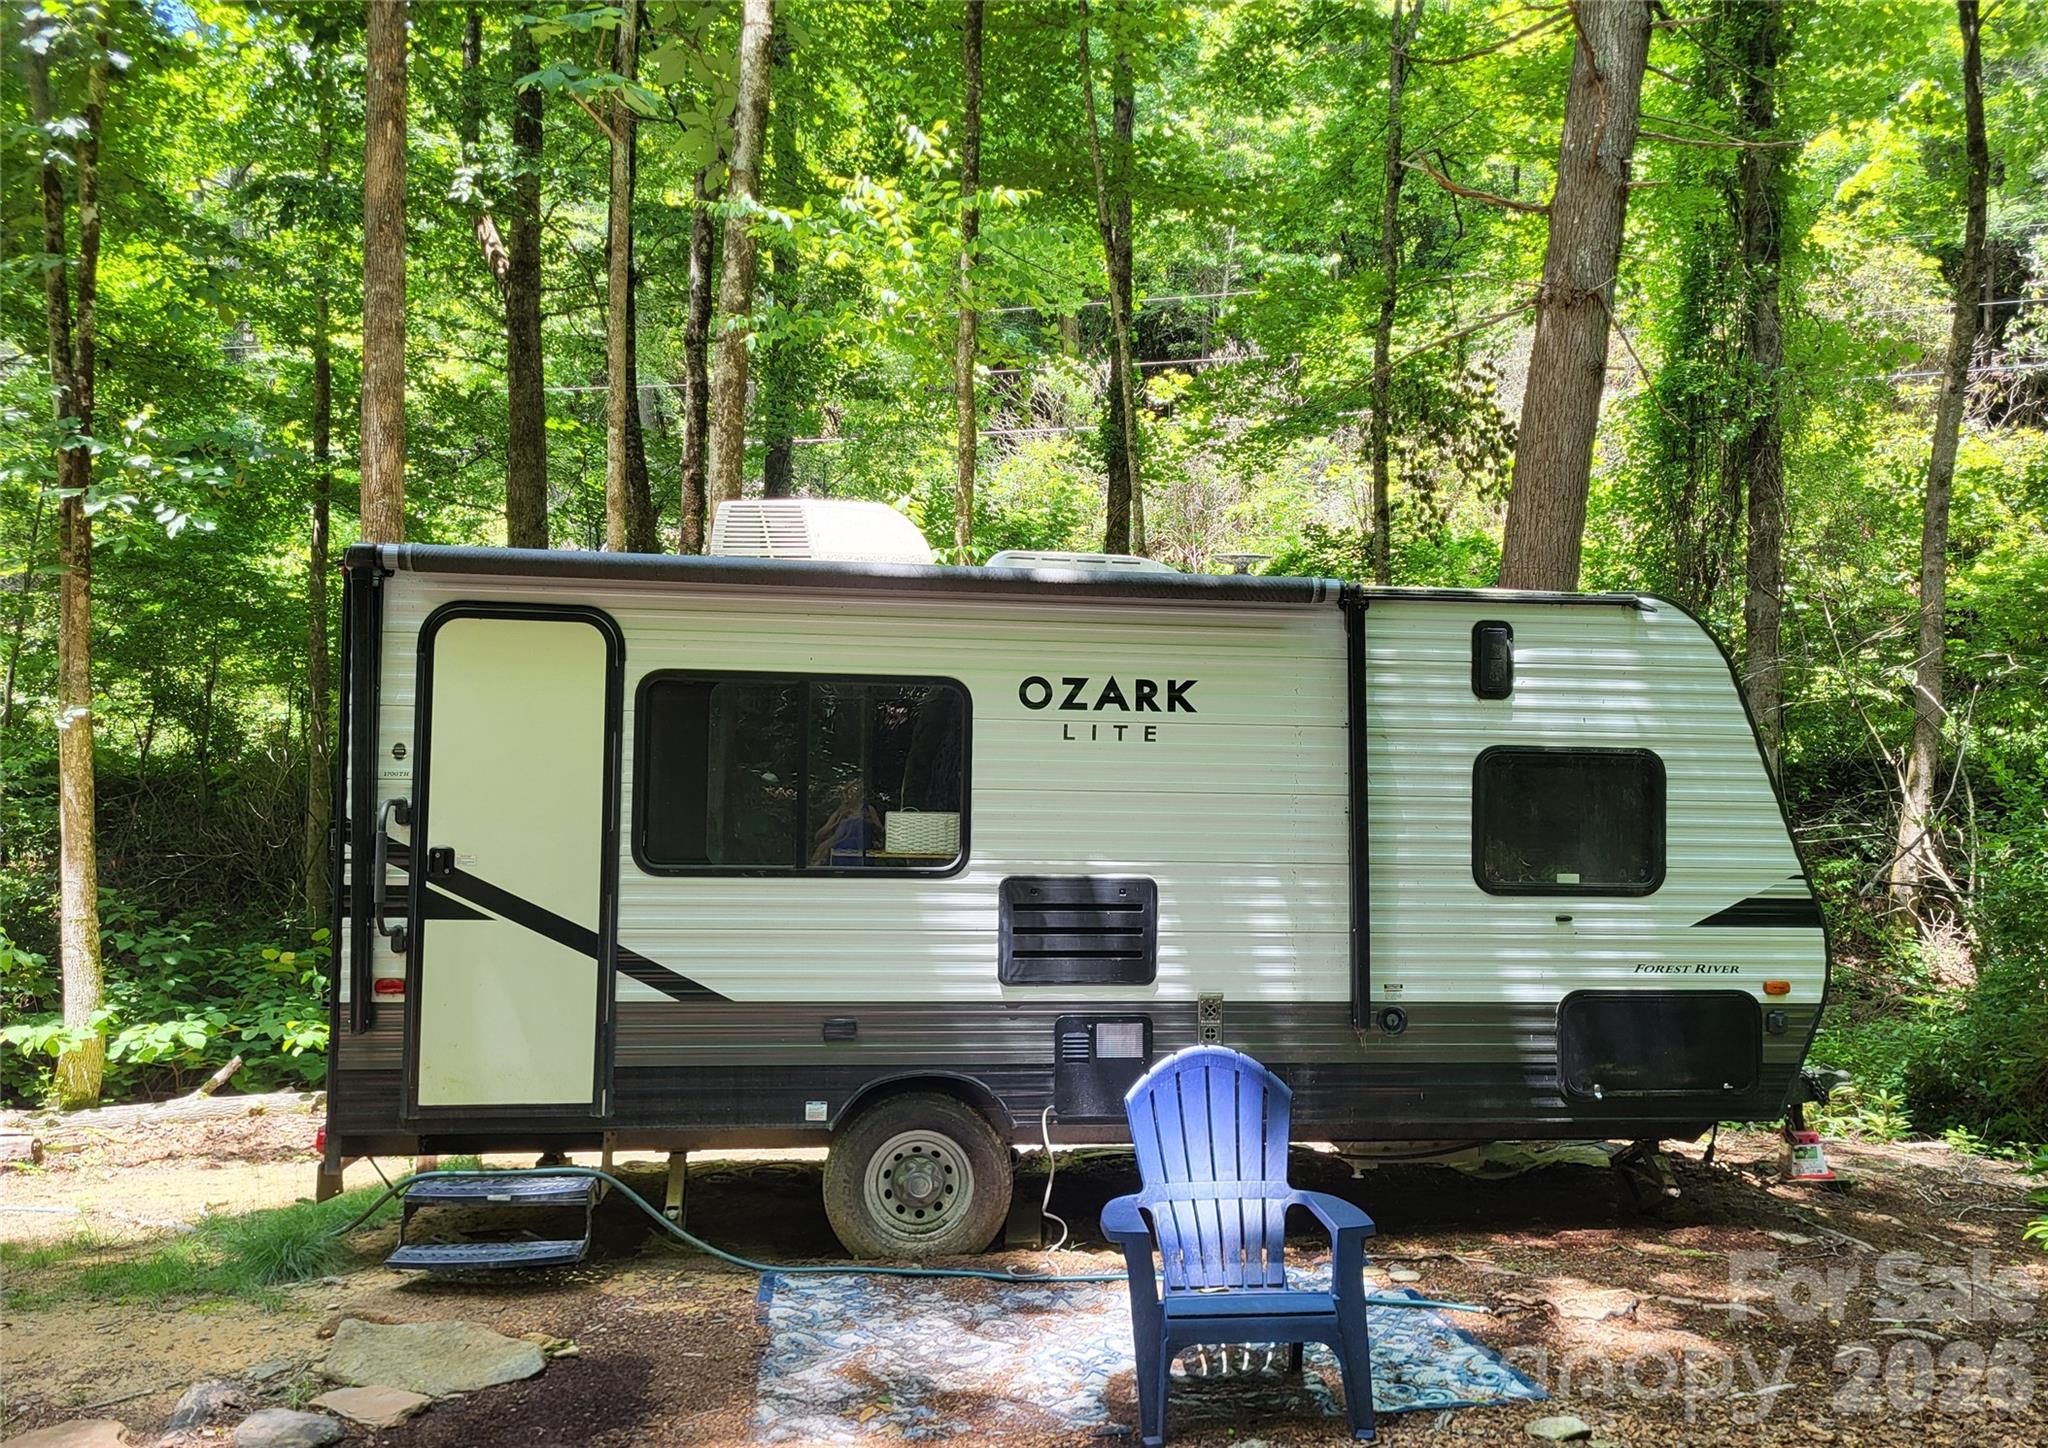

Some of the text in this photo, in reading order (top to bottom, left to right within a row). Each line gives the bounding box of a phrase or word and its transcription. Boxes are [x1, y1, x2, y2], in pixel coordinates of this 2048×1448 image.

[1019, 676, 1199, 712] OZARK
[1063, 724, 1157, 742] LITE
[1634, 963, 1740, 974] FOREST RIVER
